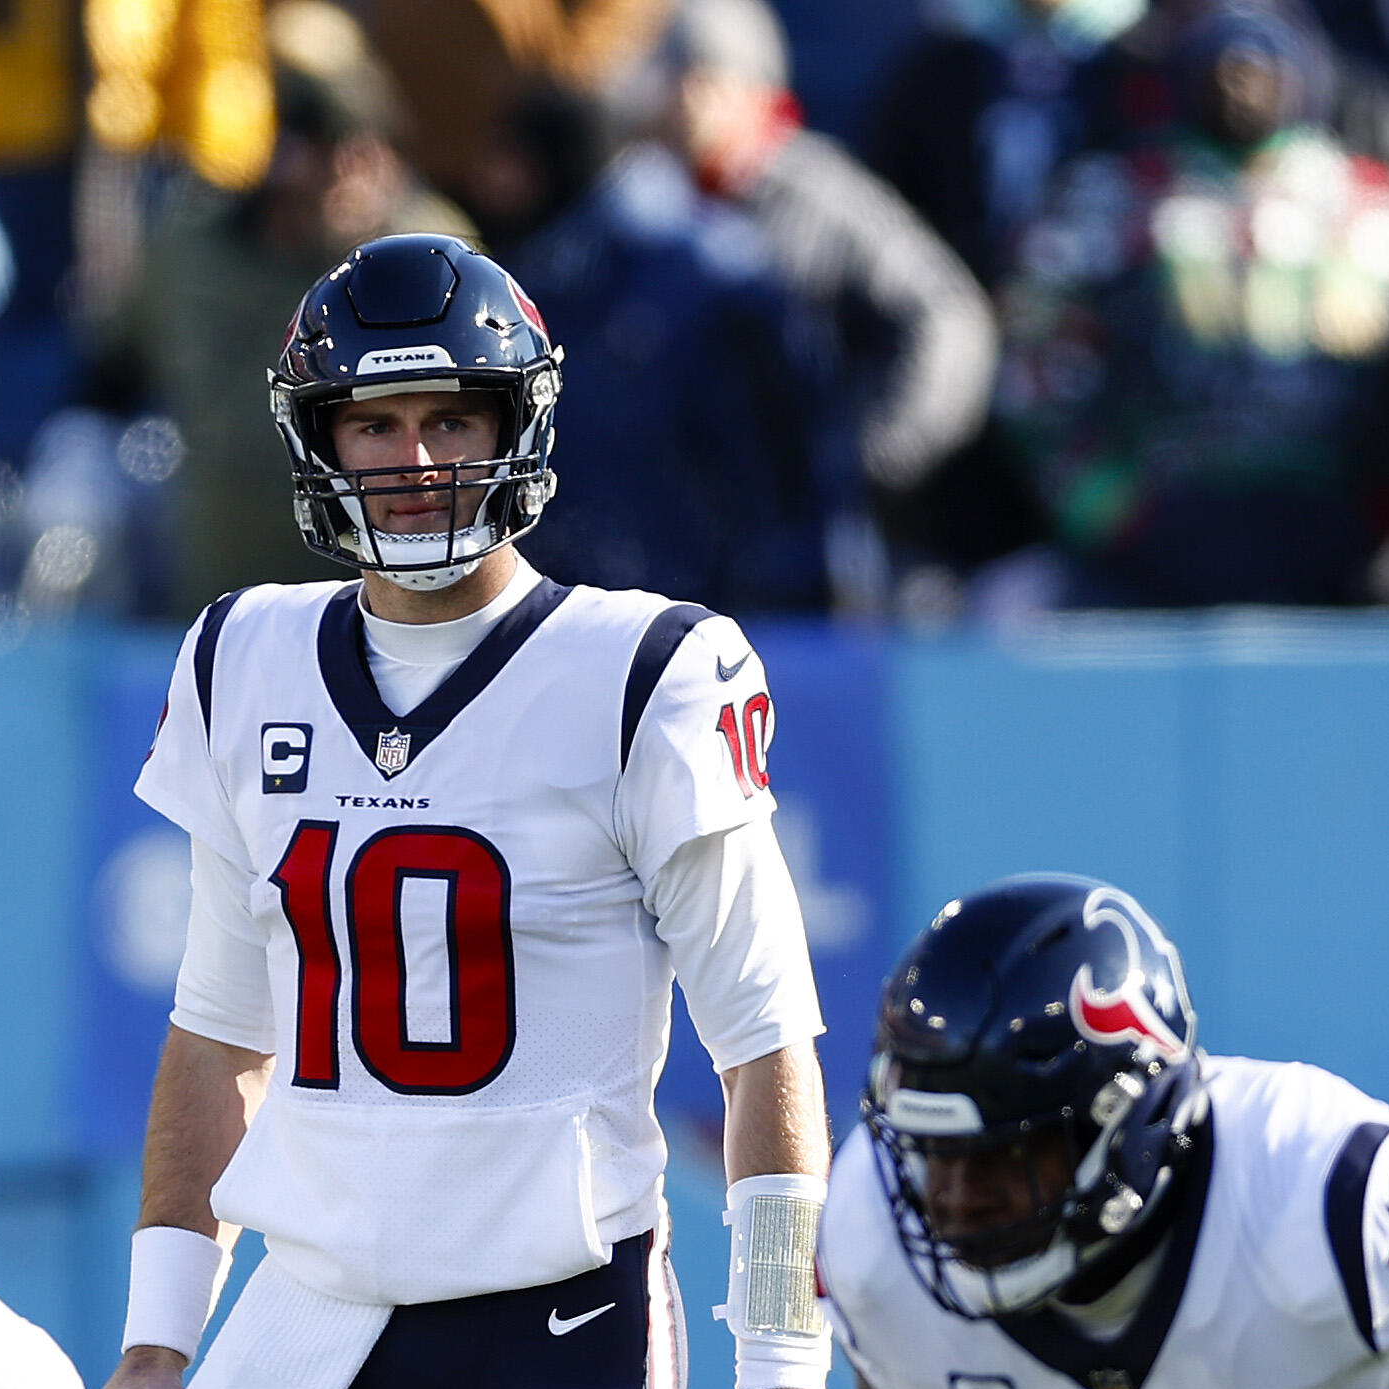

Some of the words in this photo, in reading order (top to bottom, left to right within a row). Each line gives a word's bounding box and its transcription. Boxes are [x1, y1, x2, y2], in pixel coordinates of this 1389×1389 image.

[372, 353, 436, 365] TEXANS
[262, 726, 308, 776] C
[334, 795, 431, 809] TEXANS
[267, 818, 517, 1097] 10
